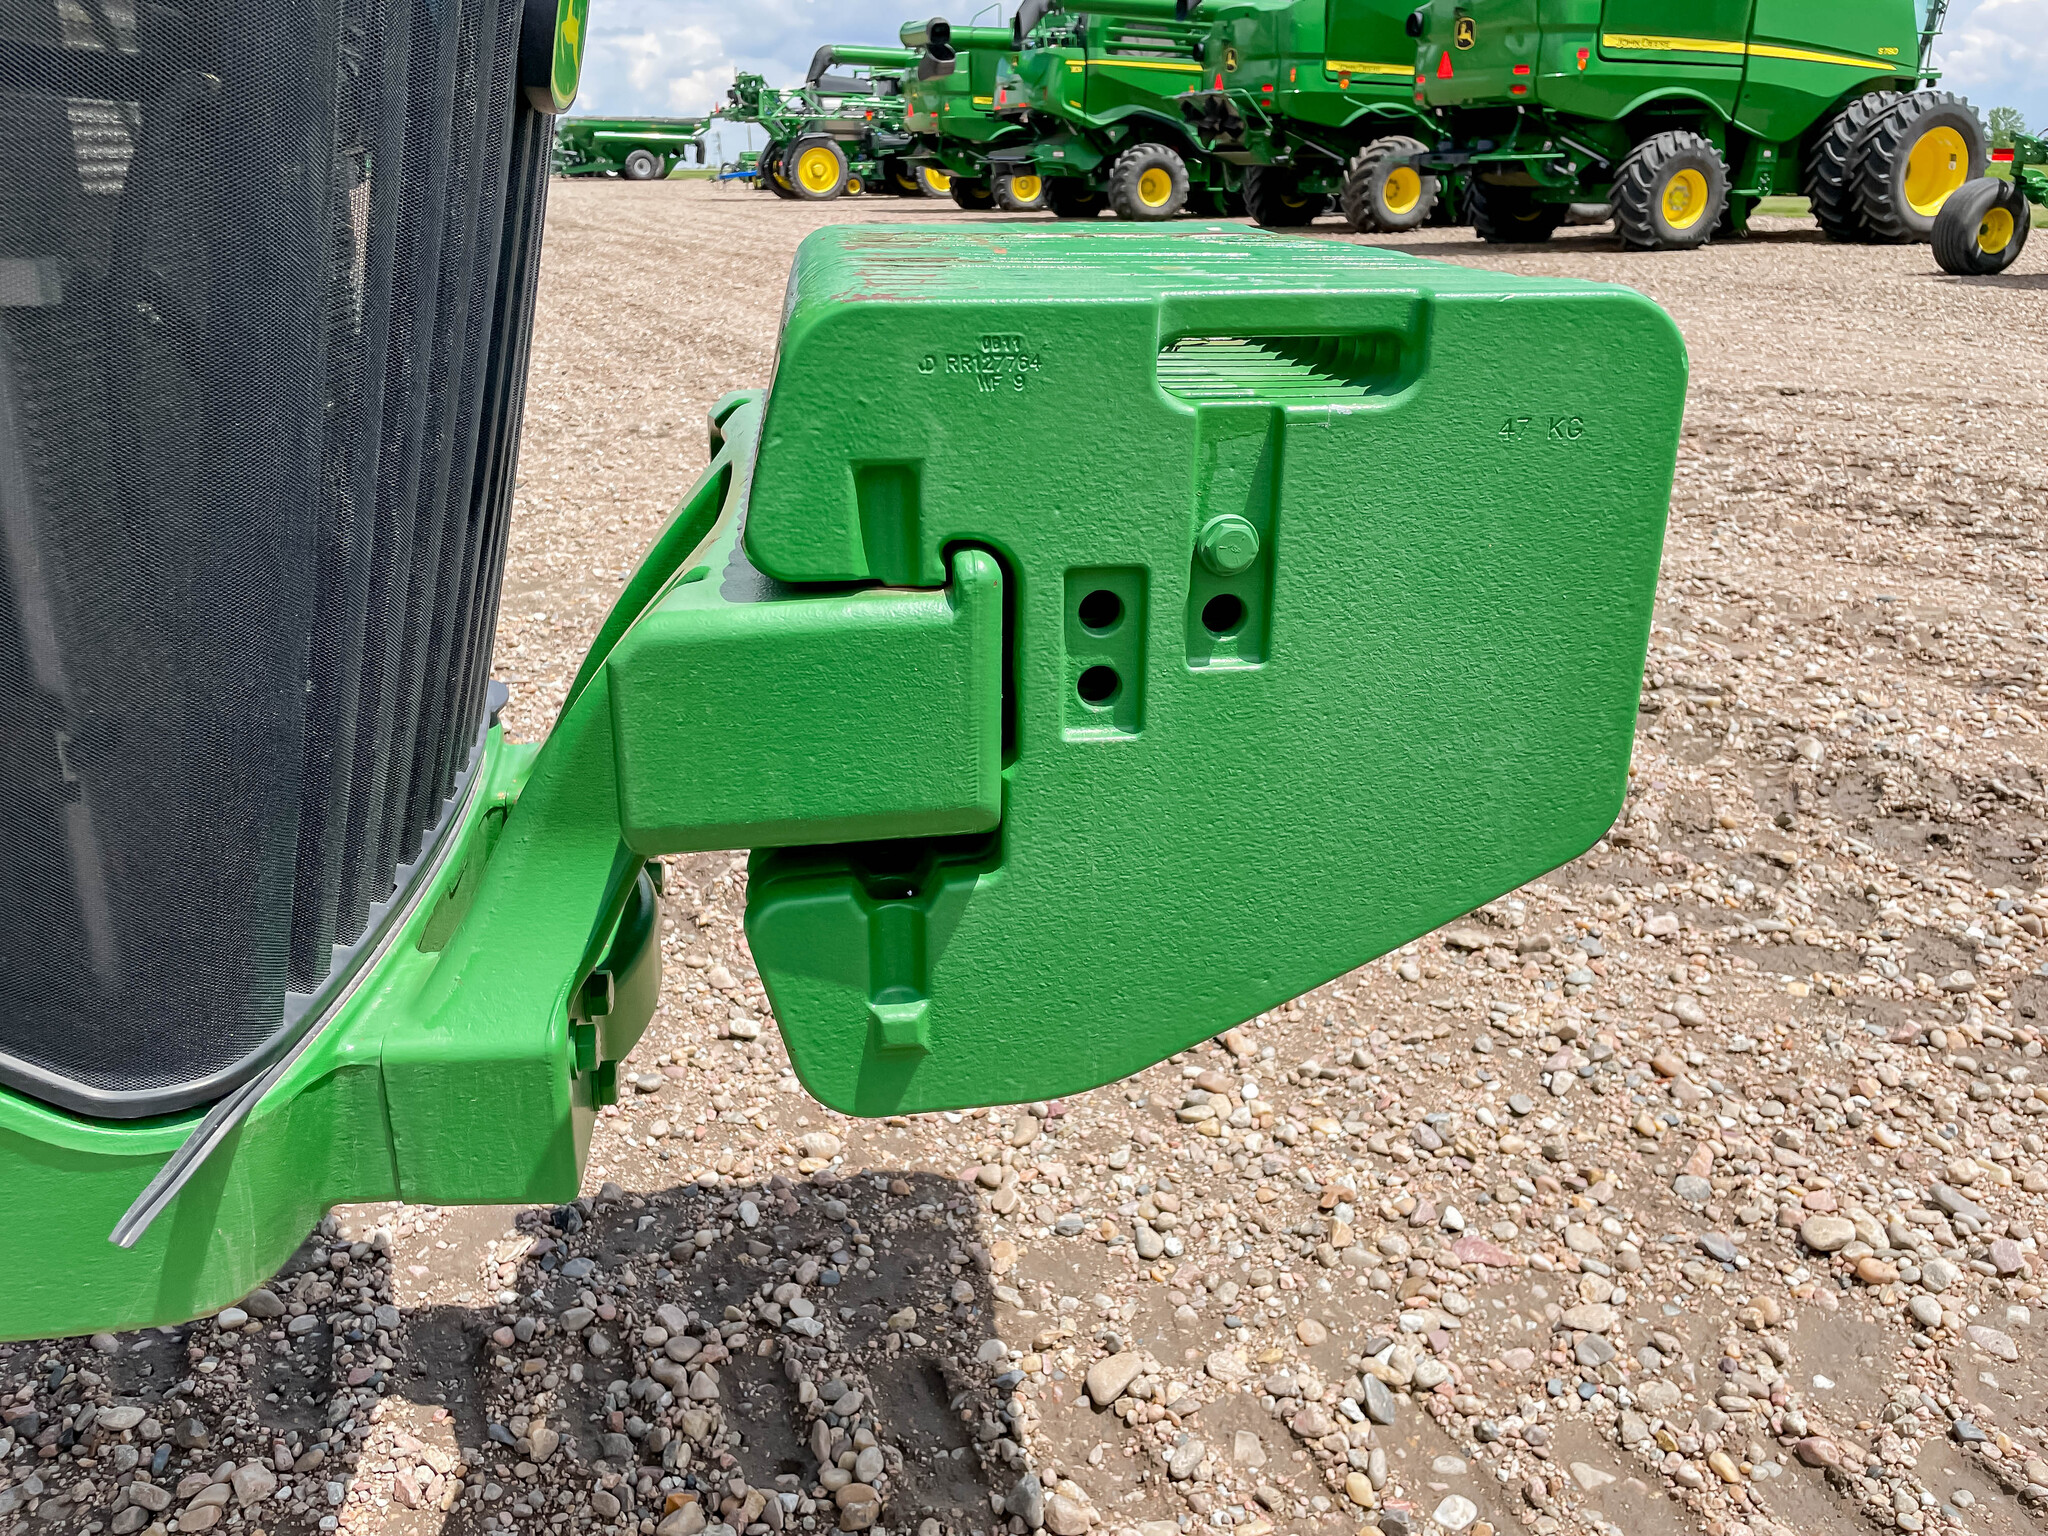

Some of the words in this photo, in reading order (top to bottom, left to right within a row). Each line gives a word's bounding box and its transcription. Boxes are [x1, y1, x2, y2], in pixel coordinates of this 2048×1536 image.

[1616, 37, 1640, 48] JOHN
[945, 353, 1043, 374] RR127764
[1498, 416, 1532, 441] 47
[1547, 416, 1584, 440] KG
